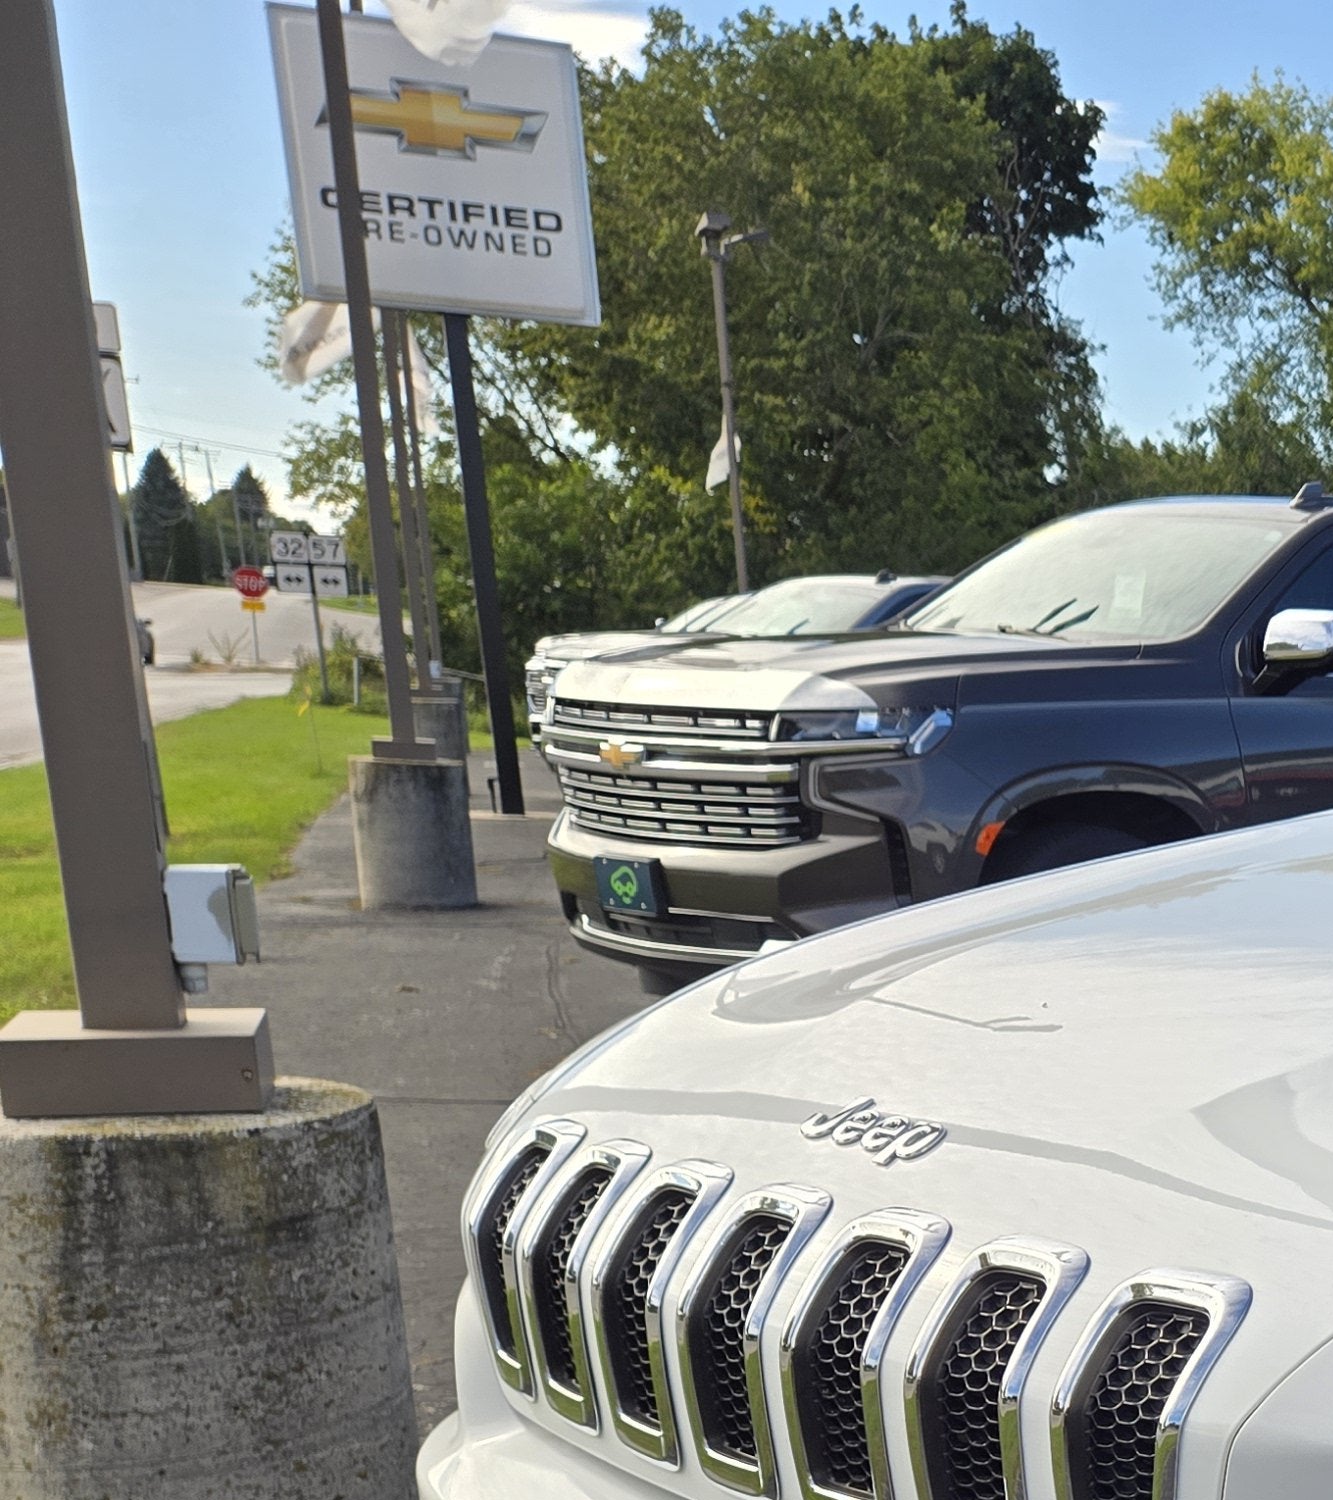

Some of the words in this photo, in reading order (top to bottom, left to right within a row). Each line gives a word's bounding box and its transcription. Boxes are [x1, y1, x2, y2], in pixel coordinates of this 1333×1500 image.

[320, 187, 562, 233] CERTIFIED
[361, 217, 553, 259] RE-OWNED
[277, 537, 305, 558] 32
[312, 539, 340, 560] 57
[235, 575, 265, 592] STOP
[800, 1096, 947, 1167] Jeep
